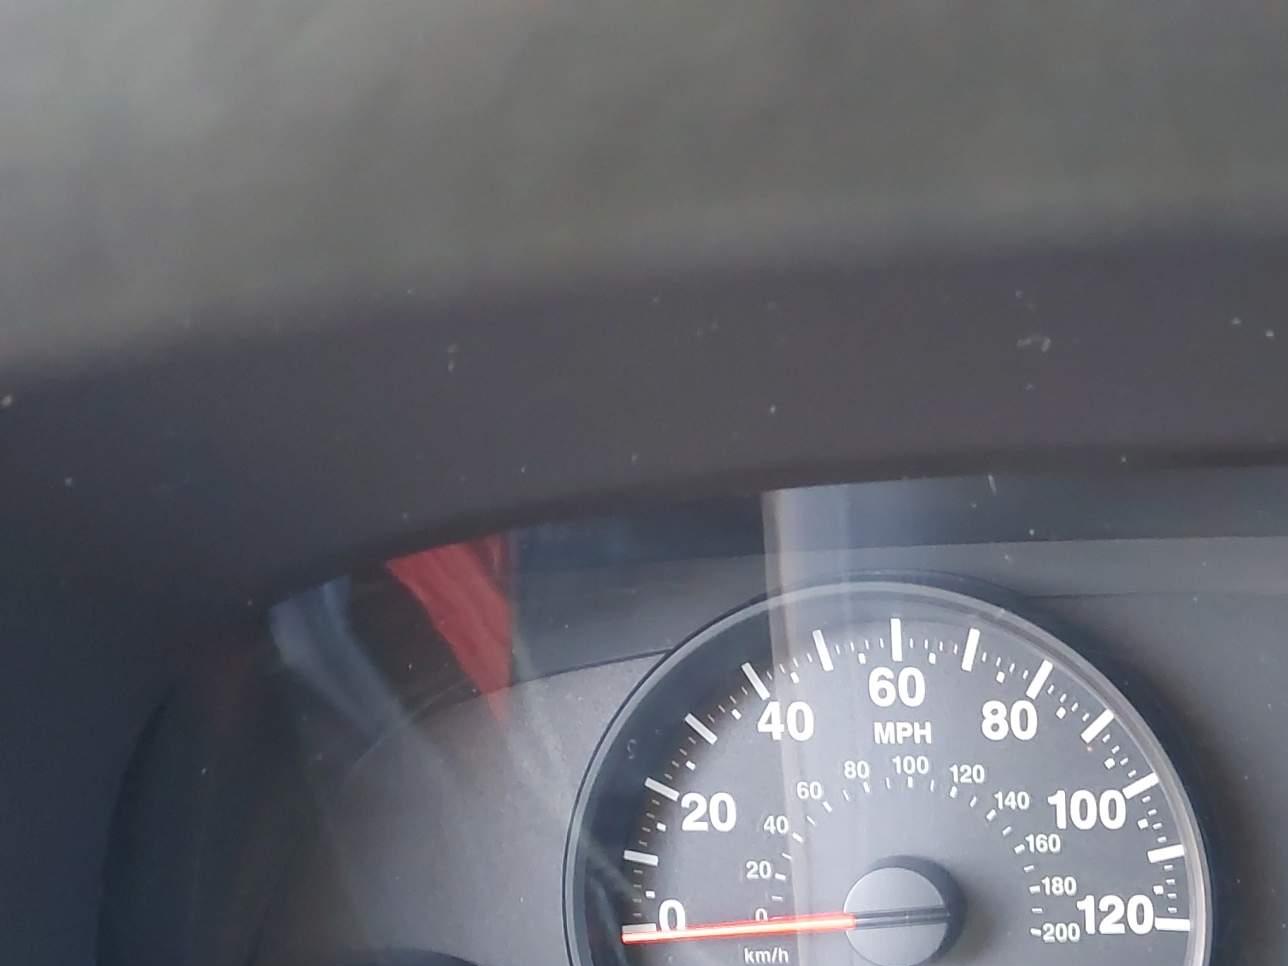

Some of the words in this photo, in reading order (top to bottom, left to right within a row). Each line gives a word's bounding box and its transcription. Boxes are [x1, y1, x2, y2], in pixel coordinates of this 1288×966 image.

[868, 667, 926, 707] 60
[758, 702, 814, 741] 40
[981, 701, 1038, 741] 80
[874, 722, 932, 744] MPH
[844, 760, 870, 779] 80
[892, 756, 929, 775] 100
[950, 765, 985, 784] 120
[796, 782, 824, 801] 60
[994, 792, 1030, 810] 140
[681, 792, 736, 832] 20
[1048, 791, 1126, 830] 100
[764, 816, 789, 834] 40
[1025, 834, 1061, 853] 160
[746, 861, 771, 879] 20
[1041, 877, 1076, 895] 180
[1077, 896, 1154, 935] 120
[1042, 923, 1080, 942] 200
[744, 947, 789, 965] km/h
